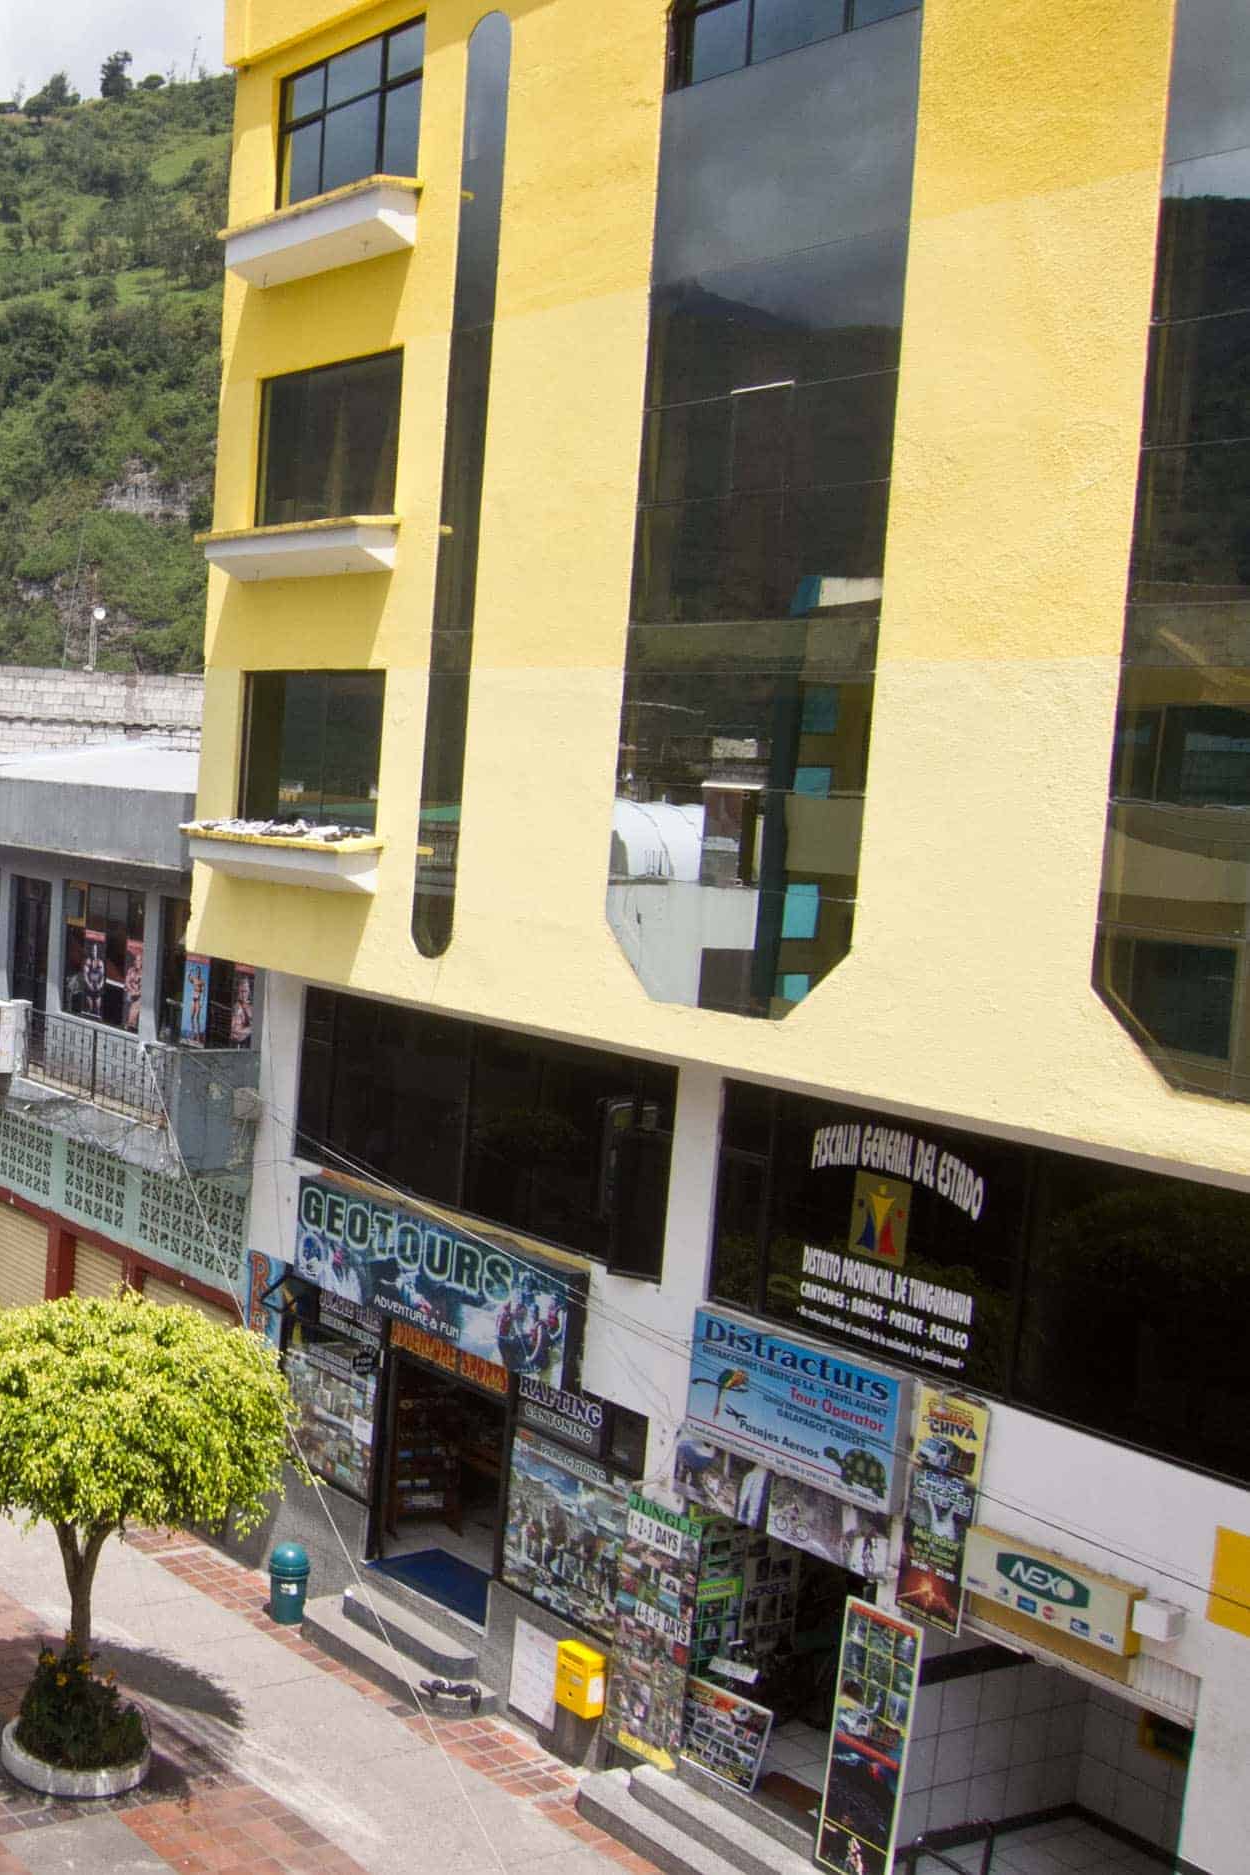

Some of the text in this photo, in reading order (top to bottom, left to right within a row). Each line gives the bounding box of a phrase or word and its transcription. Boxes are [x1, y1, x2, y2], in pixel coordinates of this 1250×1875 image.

[811, 1124, 984, 1221] FISCALIA GENERAL DEL ESTADO
[301, 1186, 513, 1303] GEOTOURS
[802, 1245, 973, 1325] DISTRITO PROVINCIAL DE TUNGURAHUA
[374, 1294, 430, 1326] ADVENTURE
[430, 1317, 438, 1329] &
[440, 1320, 460, 1339] FUN
[851, 1297, 884, 1321] BAÑOS
[888, 1309, 923, 1335] PATATE
[929, 1323, 969, 1350] PELILEO
[704, 1318, 889, 1401] Distracturs
[519, 1375, 602, 1428] RAFTING
[776, 1408, 827, 1433] GALAPAGOS
[789, 1386, 817, 1409] Tour
[822, 1399, 884, 1433] Operator
[853, 1396, 887, 1417] AGENCY
[738, 1419, 780, 1445] Pasajes
[929, 1418, 978, 1441] CHIVA
[916, 1478, 972, 1506] Cascadas
[630, 1494, 701, 1537] JUNGLE
[655, 1526, 679, 1553] DAYS
[663, 1616, 688, 1643] DAYS
